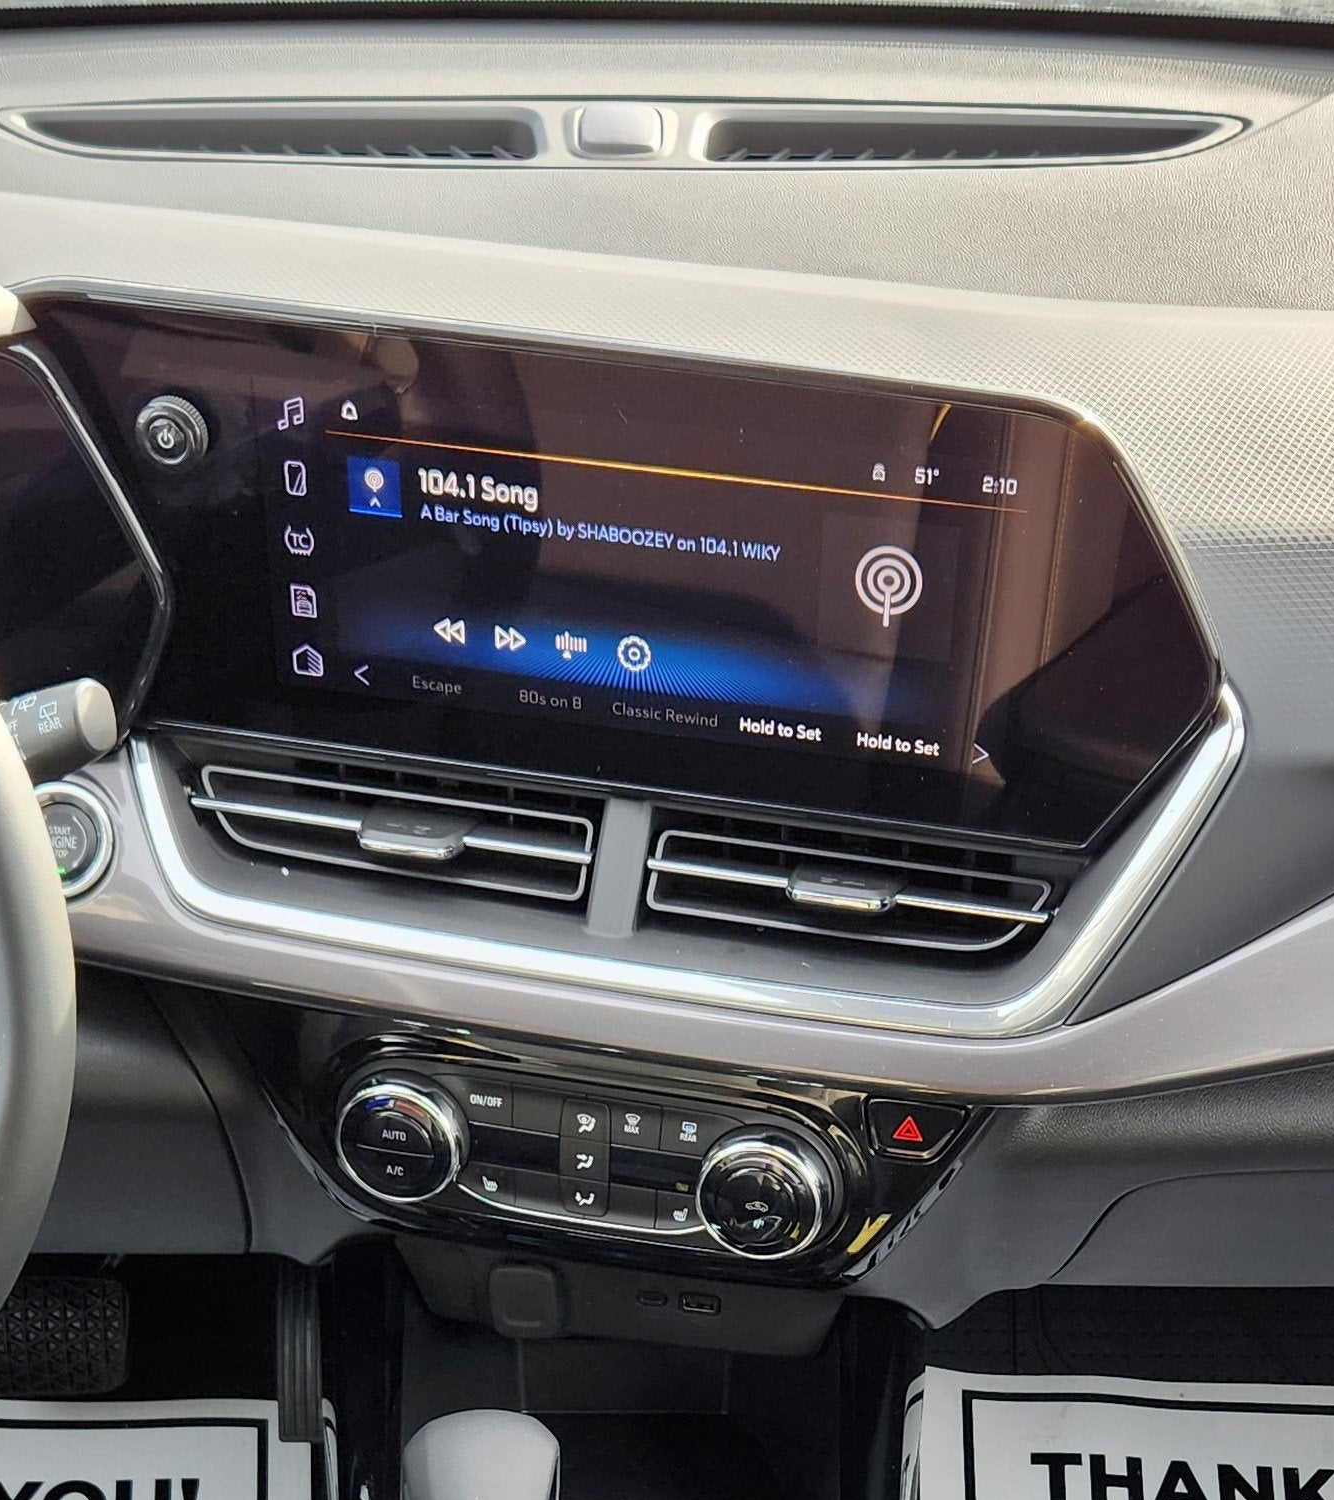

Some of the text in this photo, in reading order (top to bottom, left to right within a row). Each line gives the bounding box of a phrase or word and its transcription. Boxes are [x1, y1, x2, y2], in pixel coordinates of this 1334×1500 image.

[417, 467, 539, 513] 104.1 Song
[982, 474, 1018, 495] 2:10
[420, 503, 782, 562] A Bar Song (Tipsy) by SHABOOZEY on 104.1 WIKY
[411, 674, 462, 696] Escape
[518, 689, 547, 706] 80s
[549, 697, 568, 709] on
[612, 701, 718, 727] Classic Rewind
[38, 716, 63, 735] REAR
[739, 715, 822, 742] Hold to Set
[856, 731, 941, 757] Hold to Set
[48, 825, 72, 836] START
[52, 834, 77, 850] GINE
[469, 1093, 503, 1108] ON/OFF
[382, 1128, 407, 1141] AUTO
[623, 1124, 640, 1135] MAX
[679, 1132, 697, 1143] REAR
[386, 1164, 405, 1177] A/C
